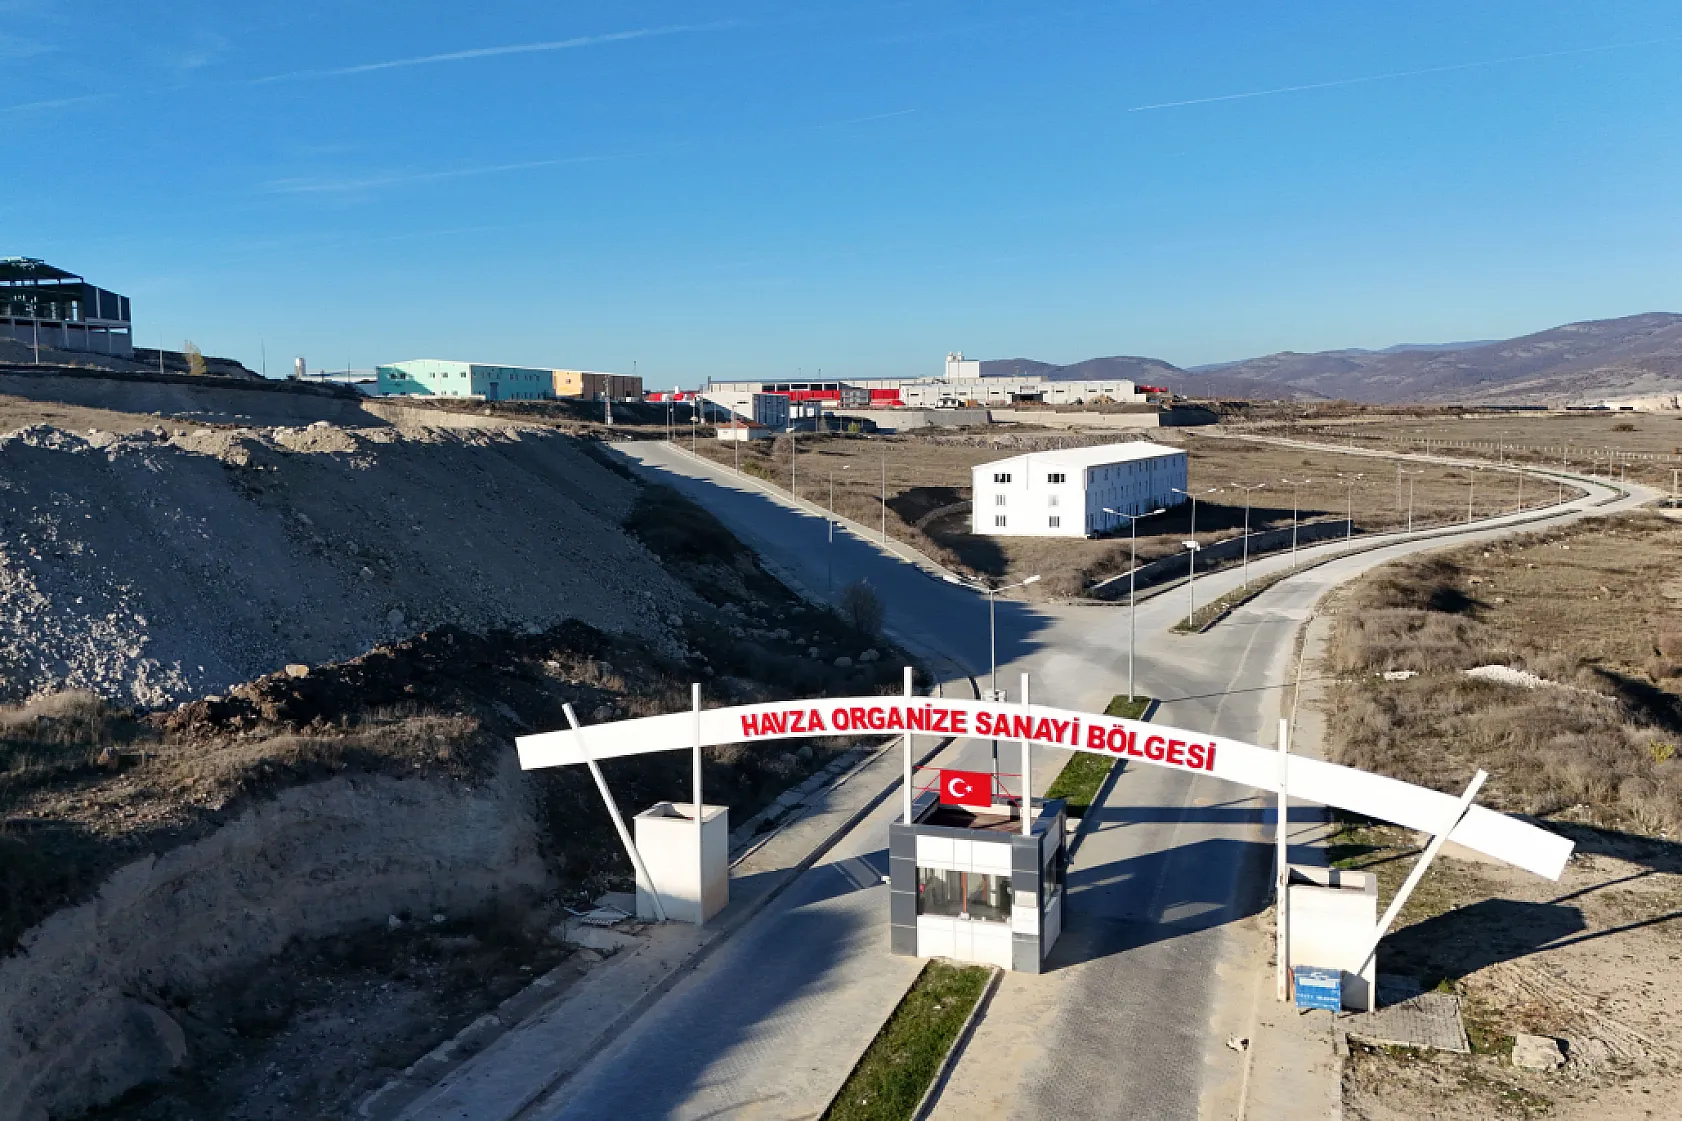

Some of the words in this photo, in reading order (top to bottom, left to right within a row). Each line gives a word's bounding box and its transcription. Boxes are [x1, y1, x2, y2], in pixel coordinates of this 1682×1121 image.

[741, 709, 826, 736] HAVZA
[832, 703, 967, 735] ORGANİZE
[976, 711, 1080, 745] SANAYİ
[1087, 723, 1216, 770] BÖLGESİ
